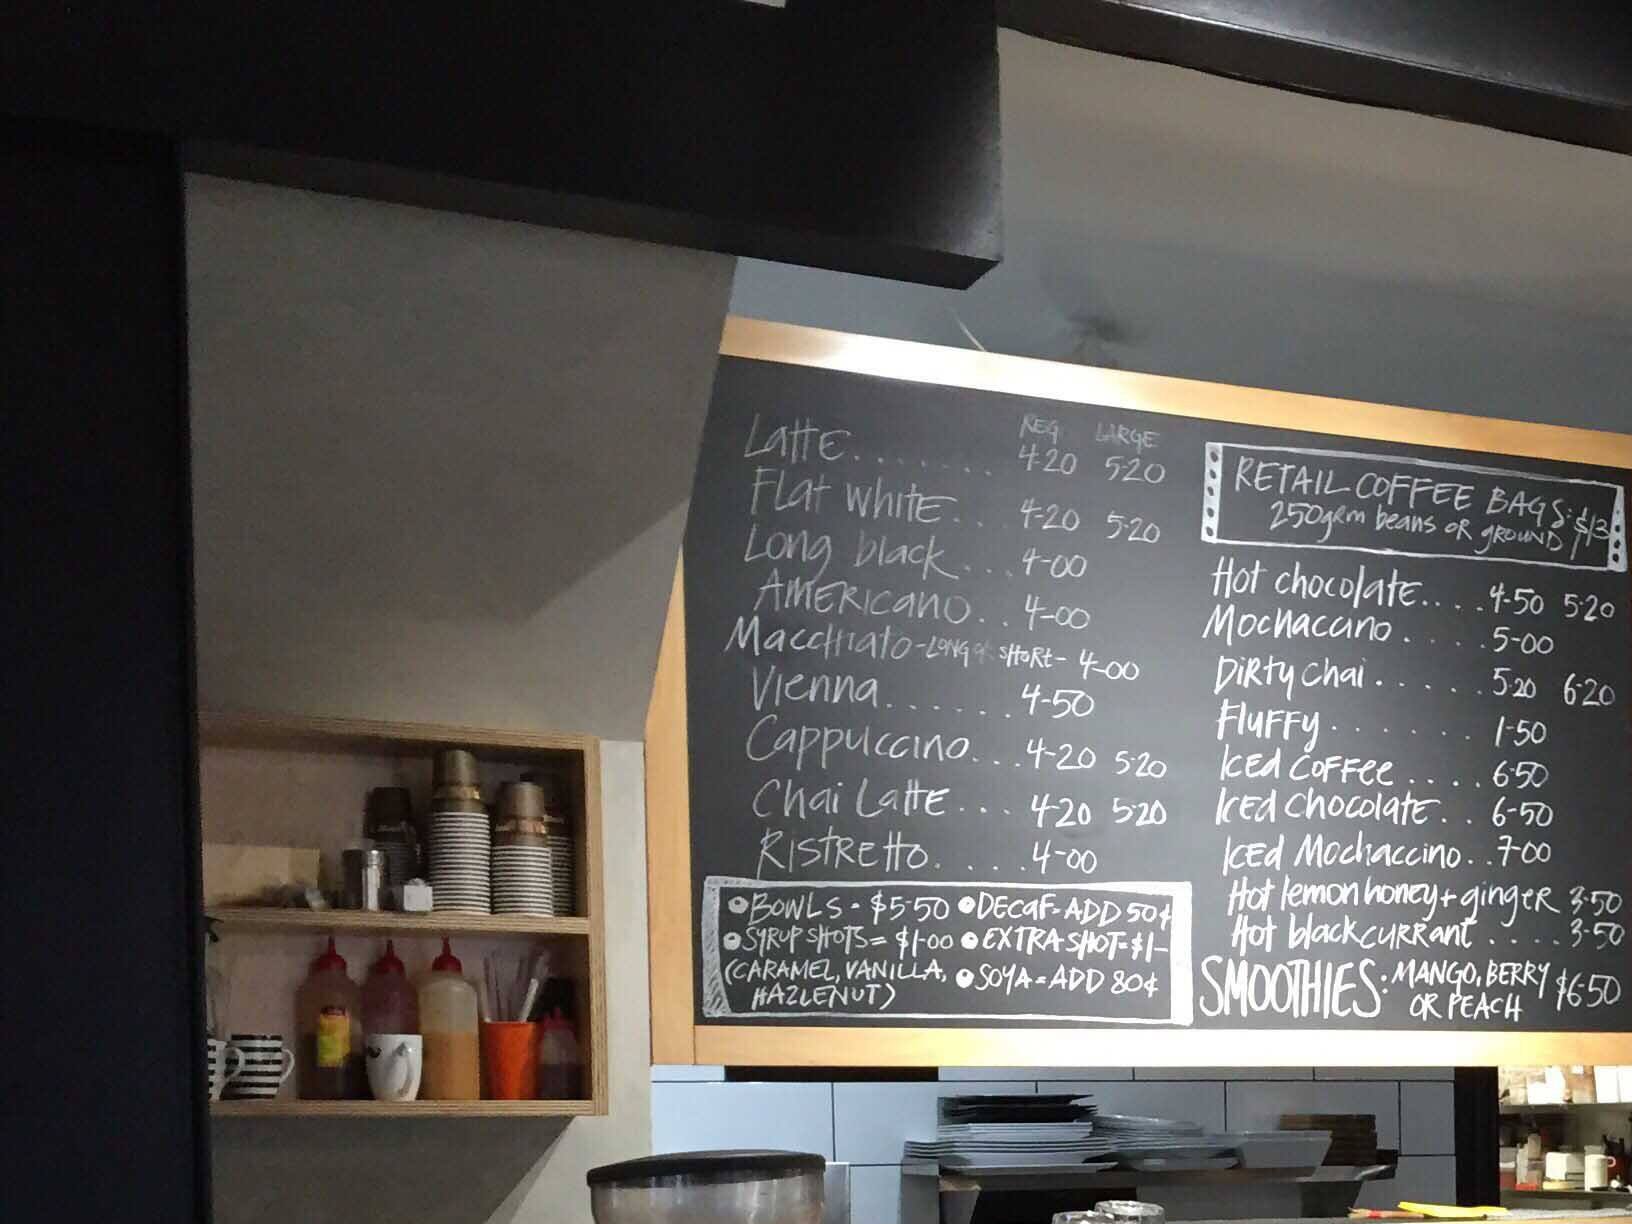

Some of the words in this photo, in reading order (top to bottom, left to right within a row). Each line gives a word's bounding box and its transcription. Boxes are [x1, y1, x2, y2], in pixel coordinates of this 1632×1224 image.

[1096, 422, 1160, 449] LARGE
[1235, 456, 1350, 495] RETAIL
[1356, 471, 1475, 511] COFFEE
[1376, 504, 1437, 535] beans
[744, 524, 832, 582] Long
[854, 536, 960, 581] black
[1210, 556, 1267, 600] Hot
[745, 713, 971, 770] Cappuccino
[752, 779, 843, 819] Chai
[748, 891, 844, 926] BOWLS
[1063, 897, 1123, 928] ADD
[1227, 877, 1276, 916] Hot
[1280, 879, 1360, 911] lemon
[742, 924, 803, 958] SYRUP
[982, 926, 1065, 956] EXTRA
[1231, 913, 1278, 957] Hot
[975, 963, 1034, 996] SOYA
[1048, 964, 1105, 995] ADD
[1486, 961, 1552, 999] BERRY
[1410, 994, 1444, 1019] OR
[1447, 991, 1524, 1023] PEACH
